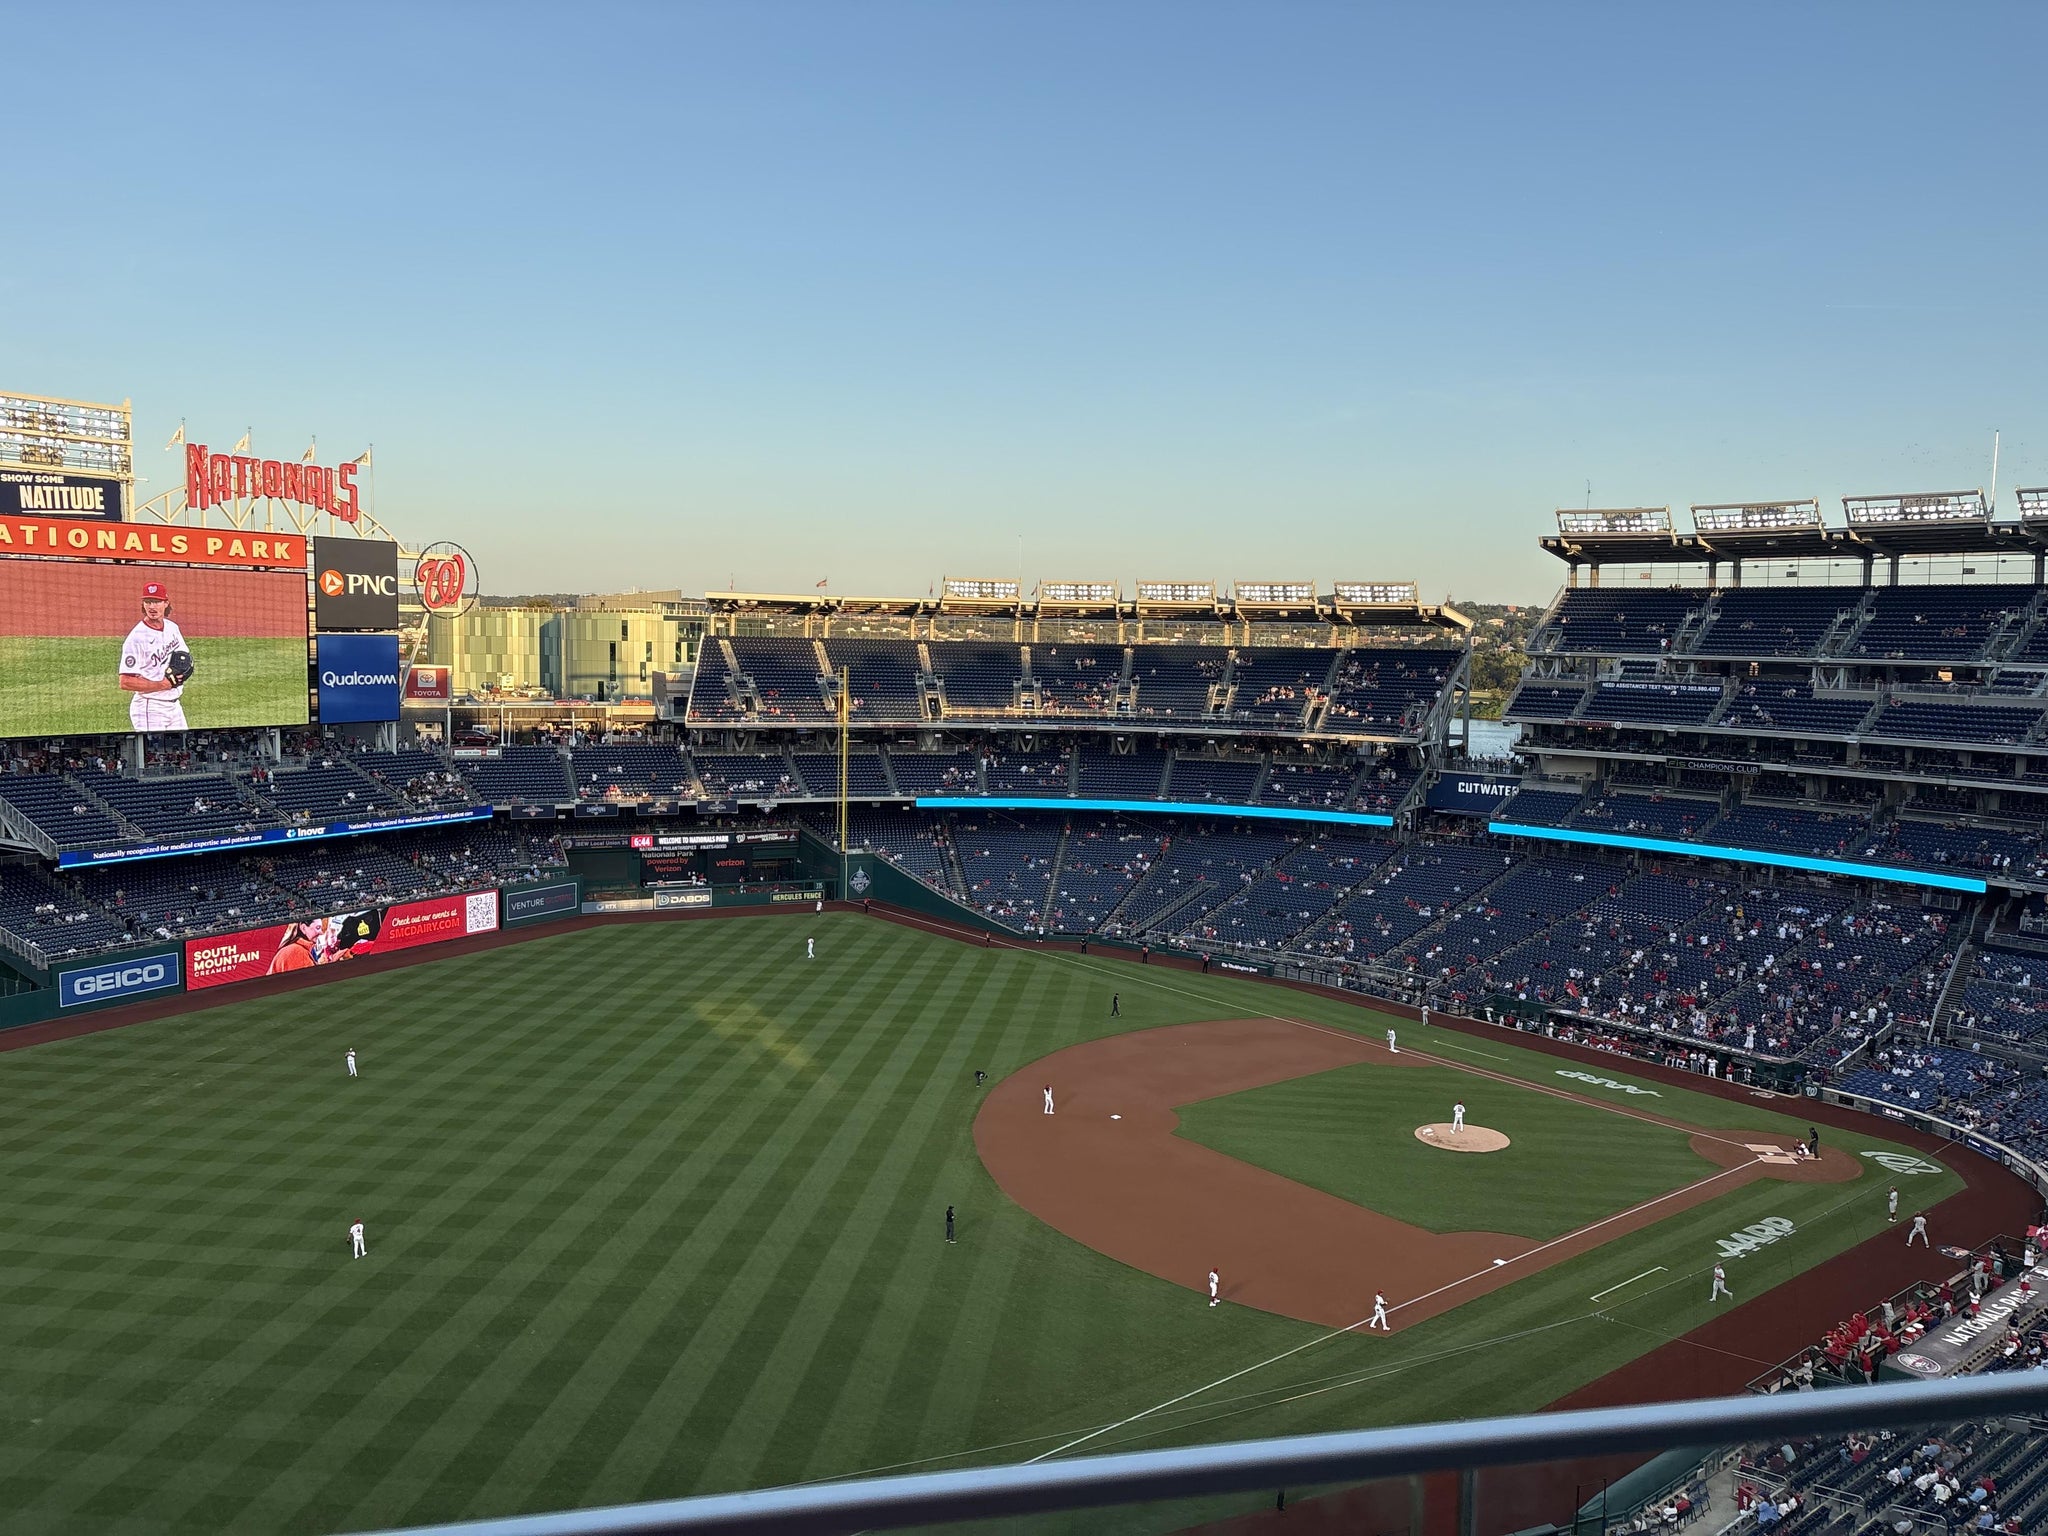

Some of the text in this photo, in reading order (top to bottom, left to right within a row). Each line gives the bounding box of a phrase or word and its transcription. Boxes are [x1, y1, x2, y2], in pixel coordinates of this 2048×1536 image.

[0, 474, 64, 484] SHOW SOME
[186, 443, 358, 523] NATIONALS
[19, 484, 105, 510] NATITUDE
[207, 537, 290, 560] PARK
[346, 573, 396, 596] PNC
[322, 671, 397, 688] Qualcomm
[413, 689, 441, 697] TOYOTA
[1688, 761, 1735, 771] CHAMPIONS
[1736, 766, 1758, 774] CLUB
[1458, 782, 1519, 796] CUTWATER
[349, 819, 372, 830] Nationally
[298, 827, 325, 837] Inova
[633, 837, 650, 847] 6:44
[658, 836, 682, 845] WELCOME
[713, 835, 729, 843] PARK
[93, 848, 126, 859] Nationally
[126, 845, 160, 856] recognized
[160, 844, 170, 852] for
[170, 841, 193, 850] medical
[193, 839, 219, 850] expertise
[219, 838, 231, 846] and
[231, 836, 249, 846] patient
[641, 851, 675, 859] Nationals
[646, 856, 689, 866] powered by
[654, 865, 682, 873] Verizon
[716, 859, 745, 867] verizon
[670, 895, 710, 904] DABOS
[773, 892, 823, 901] HERCULES FENCE
[511, 897, 545, 911] VENTURE
[392, 917, 411, 927] Check
[411, 916, 421, 924] out
[421, 914, 431, 922] our
[432, 911, 450, 919] events
[389, 918, 459, 939] SMCDAIRY.COM
[193, 945, 236, 961] SOUTH
[193, 951, 260, 972] MOUNTAIN
[194, 965, 237, 978] CREAMERY
[73, 965, 165, 996] GEICO
[1715, 1216, 1796, 1258] AARP
[1941, 1303, 2012, 1346] NATIONALS
[1880, 1430, 1890, 1440] 26
